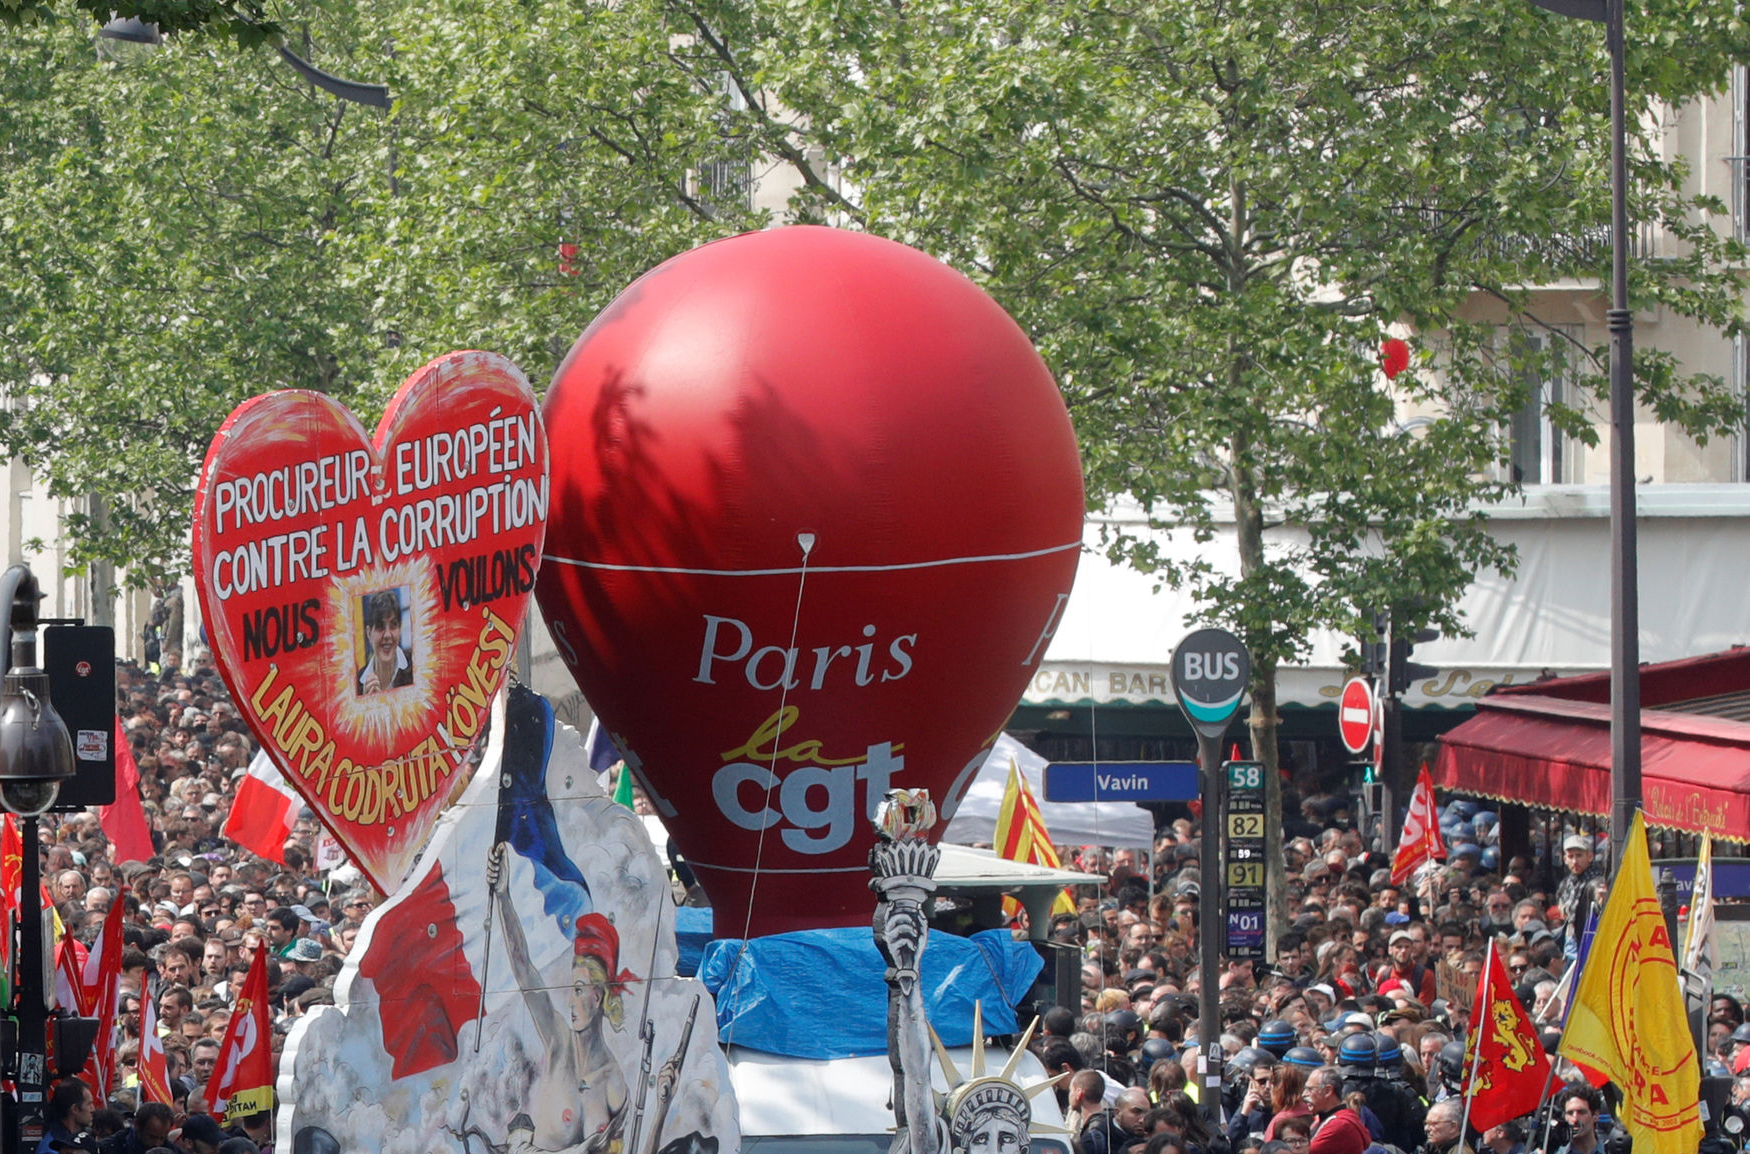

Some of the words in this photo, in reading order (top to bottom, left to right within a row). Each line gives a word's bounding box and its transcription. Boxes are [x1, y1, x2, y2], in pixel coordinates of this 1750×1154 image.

[215, 449, 371, 534] PROCUREUR
[395, 405, 537, 496] EUROPÉEN
[213, 524, 329, 601] CONTRE
[336, 515, 371, 573] LA
[380, 474, 549, 564] CORRUPTION
[243, 600, 321, 663] NOUS
[436, 545, 536, 612] VOULONS
[692, 613, 918, 692] Paris
[1109, 671, 1167, 695] BAR
[1183, 651, 1240, 682] BUS
[250, 663, 333, 796] LAURA
[328, 741, 453, 827] CODRUTA
[720, 705, 907, 767] la
[711, 740, 906, 855] cgt
[1097, 773, 1149, 791] Vavin
[1233, 767, 1260, 788] 58
[1233, 816, 1259, 836] 82
[1233, 864, 1258, 884] 91
